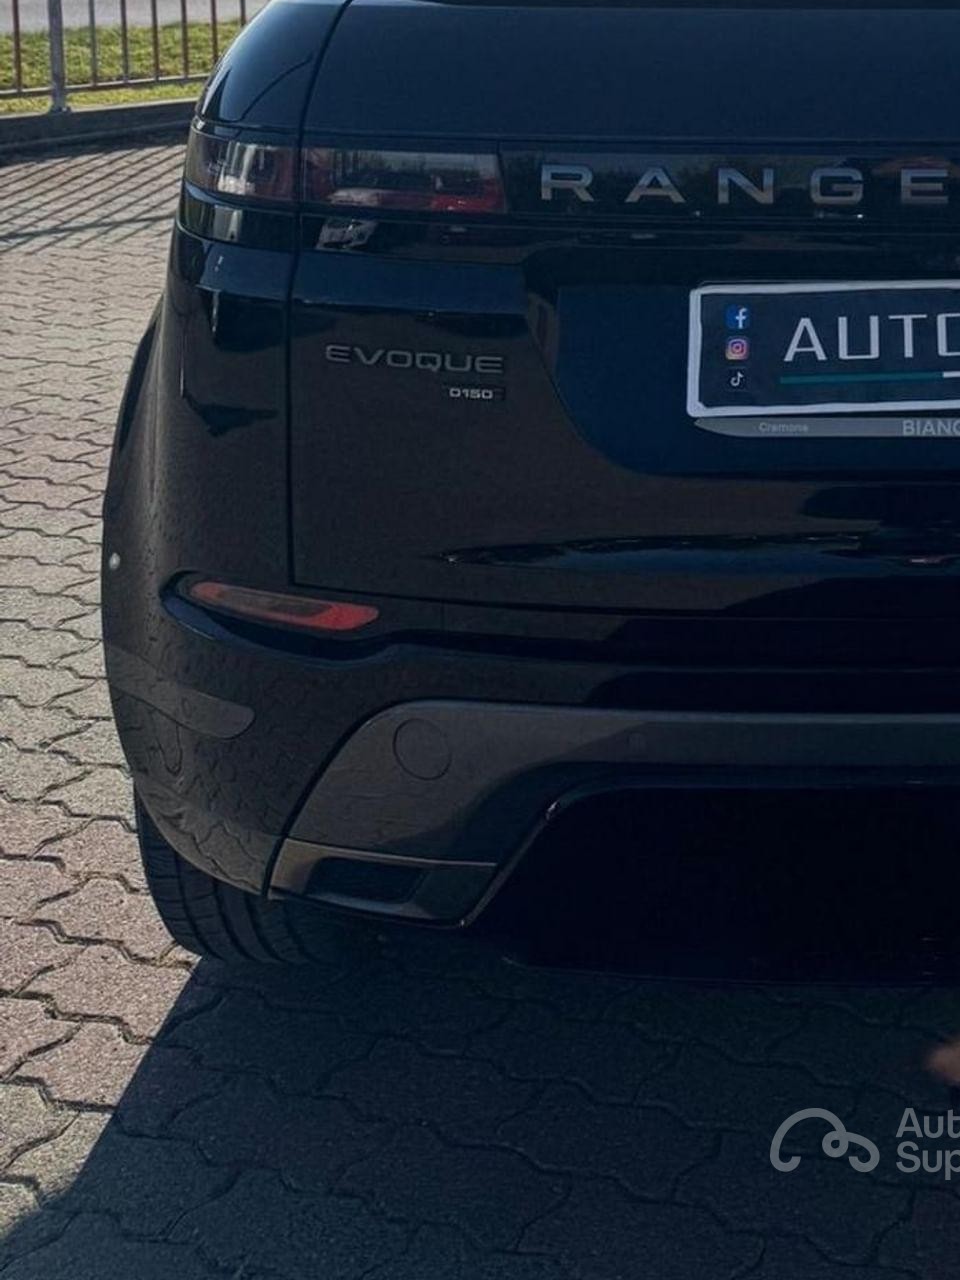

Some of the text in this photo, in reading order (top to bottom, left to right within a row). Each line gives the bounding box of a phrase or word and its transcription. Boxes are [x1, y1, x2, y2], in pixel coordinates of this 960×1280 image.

[541, 164, 949, 206] RANGE
[325, 344, 503, 373] EVOQUE
[449, 387, 494, 400] D150
